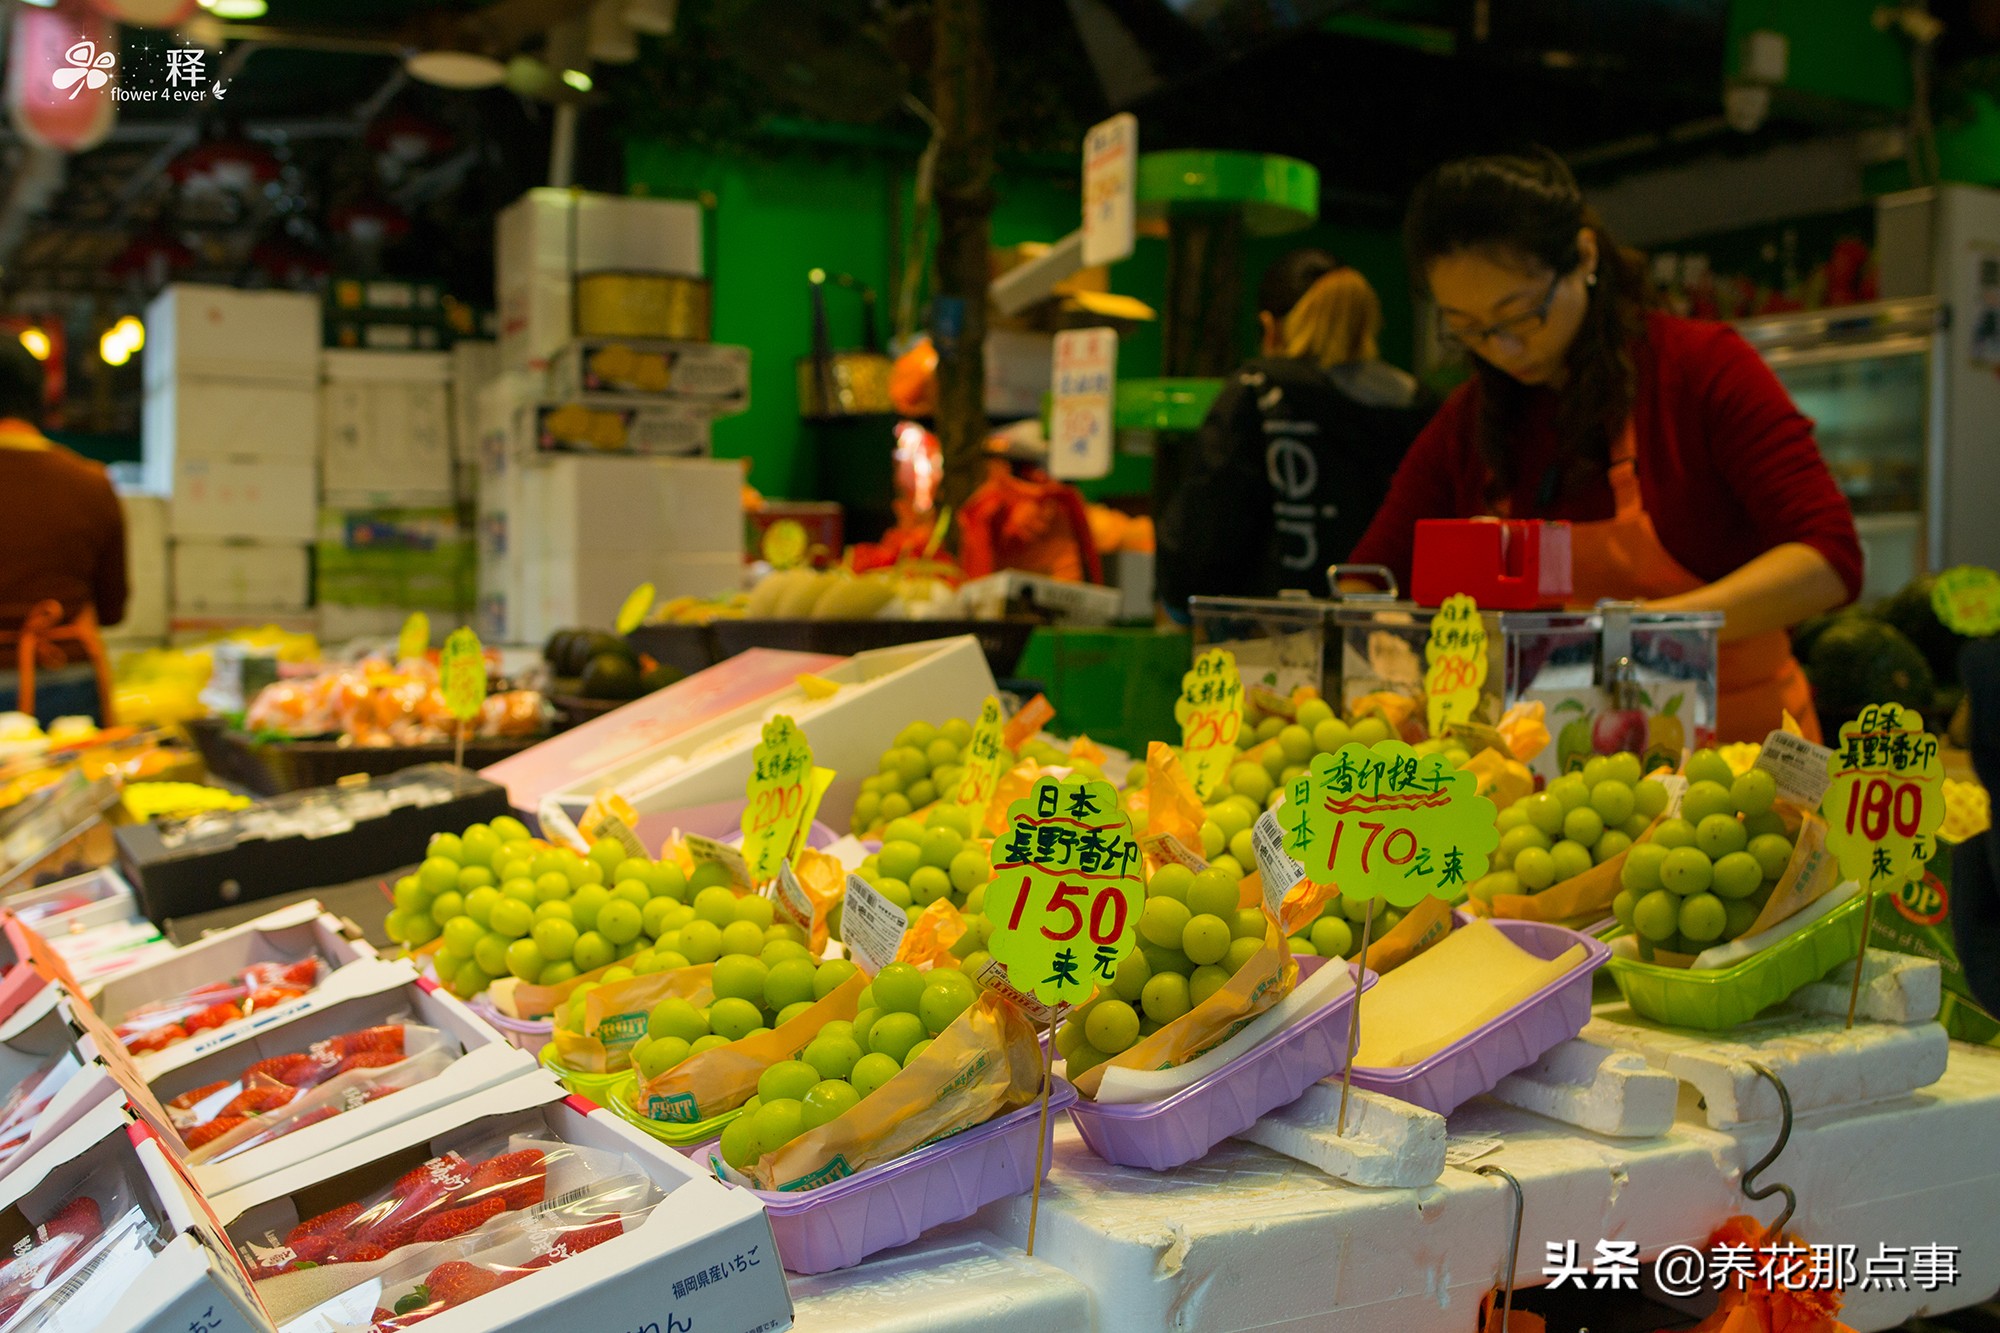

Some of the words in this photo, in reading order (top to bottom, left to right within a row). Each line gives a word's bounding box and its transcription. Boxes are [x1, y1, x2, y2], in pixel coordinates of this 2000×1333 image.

[1431, 654, 1478, 696] 280
[1184, 710, 1240, 753] 250
[1860, 707, 1903, 734] 日本
[1037, 784, 1102, 822] 日本
[1320, 752, 1456, 803] 香印提子
[752, 784, 803, 833] 200
[1289, 780, 1316, 852] 日本
[1845, 778, 1923, 842] 180
[1005, 822, 1138, 879] 長野香印
[1327, 820, 1418, 874] 170
[1007, 876, 1128, 946] 150
[671, 1245, 761, 1300] 福岡県産いちご
